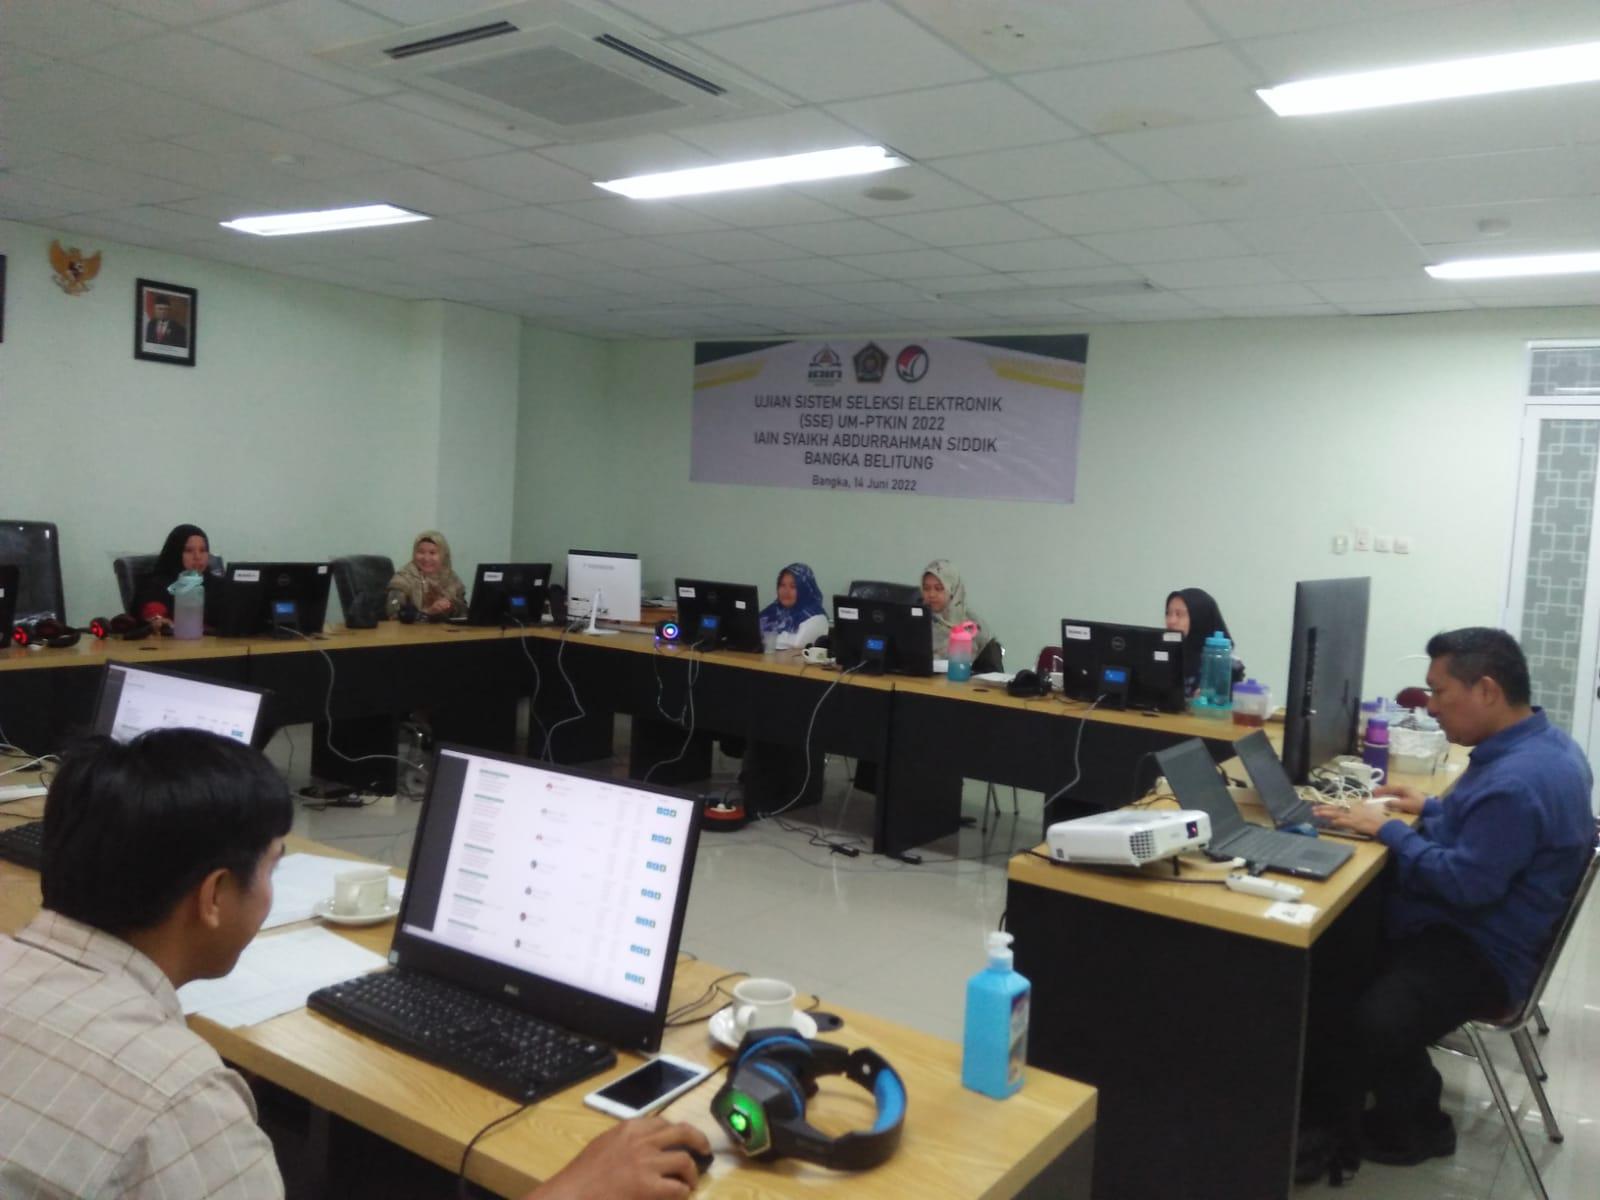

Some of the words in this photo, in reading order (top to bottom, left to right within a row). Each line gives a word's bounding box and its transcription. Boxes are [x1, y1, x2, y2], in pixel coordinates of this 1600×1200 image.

[755, 395, 791, 408] UJIAN
[795, 395, 842, 409] SISTEM
[846, 395, 904, 410] SELEKSI
[908, 396, 1002, 411] ELEKTRONIK
[800, 414, 833, 428] (SSE)
[838, 415, 907, 429] UM-PTKIN
[912, 416, 945, 431] 2022
[754, 431, 779, 445] IAIN
[783, 432, 829, 447] SYAIKH
[832, 433, 942, 450] ABDURRAHMAN
[946, 437, 998, 452] SIDDIK
[804, 451, 860, 466] BANGKA
[864, 453, 934, 470] BELITUNG
[867, 478, 888, 489] Juni
[891, 480, 917, 491] 2022
